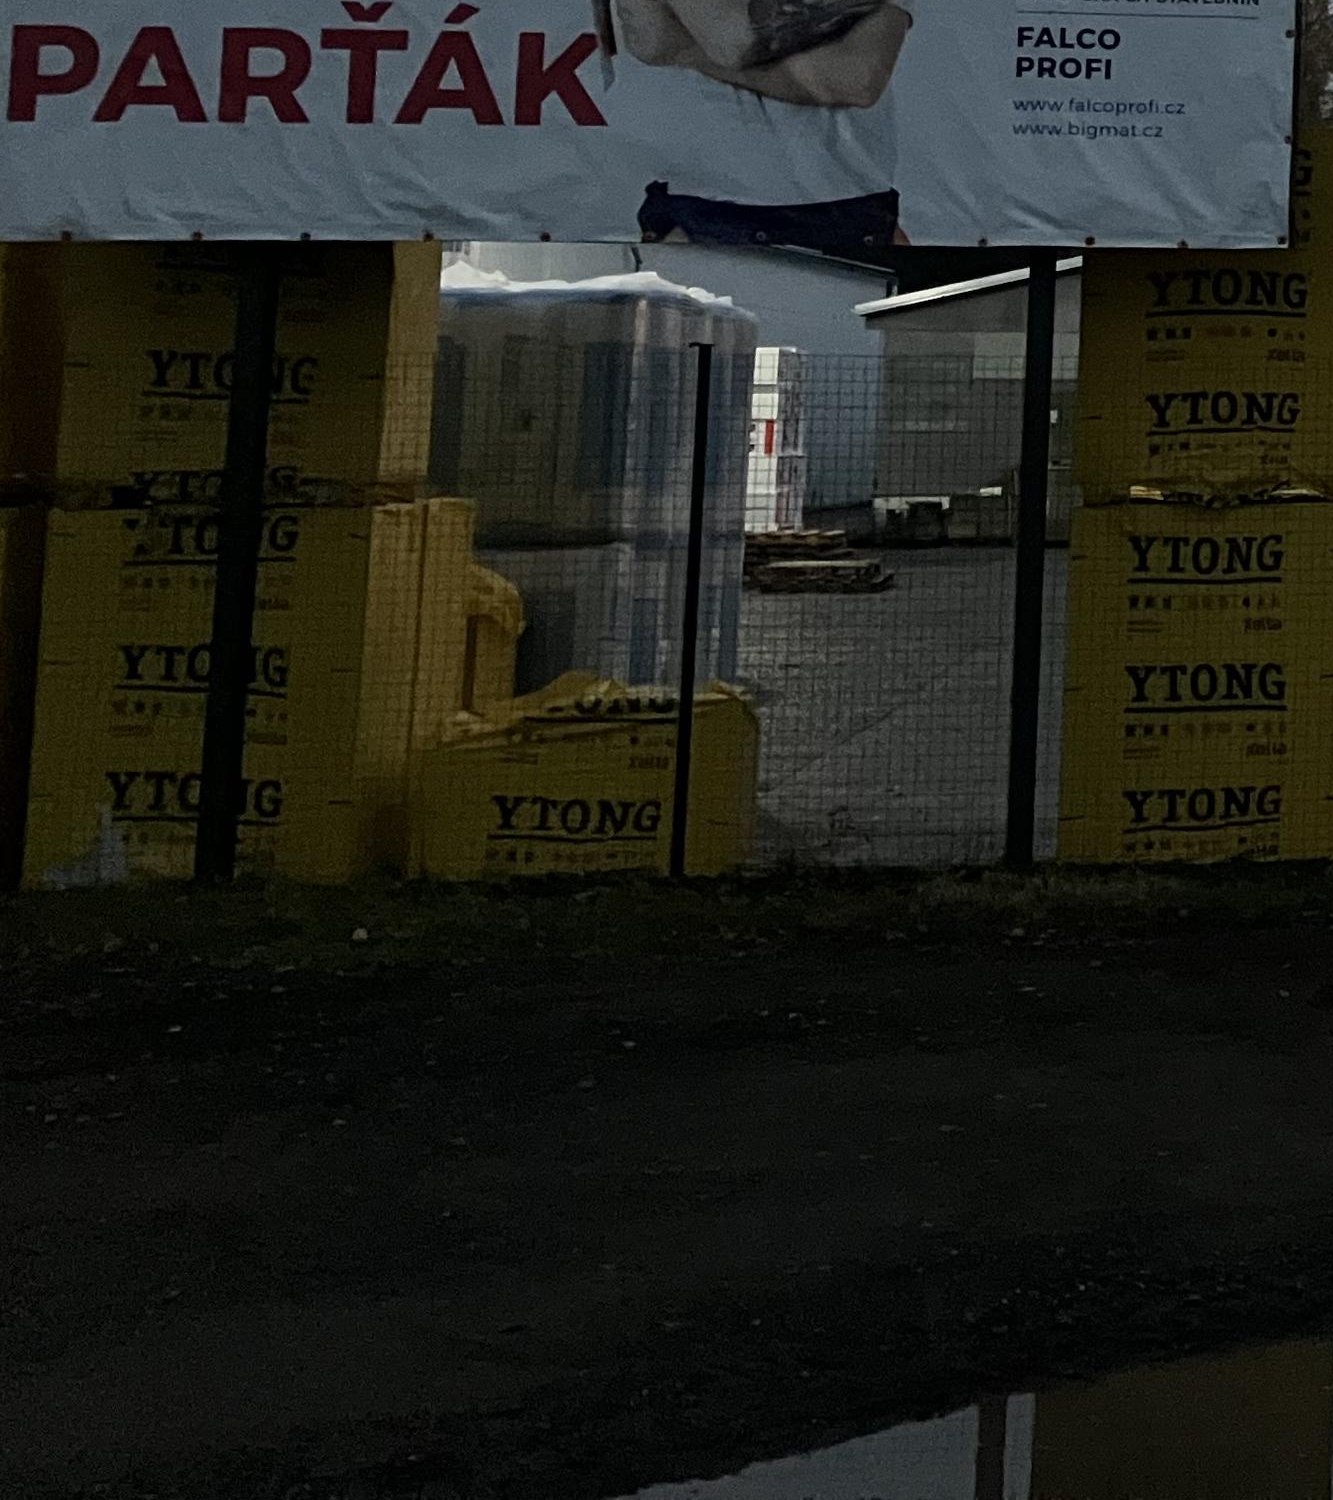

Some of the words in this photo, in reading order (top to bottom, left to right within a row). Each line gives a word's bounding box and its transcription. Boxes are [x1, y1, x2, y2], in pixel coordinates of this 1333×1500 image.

[1017, 26, 1121, 51] FALCO
[4, 0, 610, 128] PARŤÁK
[1015, 56, 1113, 80] PROFI
[1012, 97, 1186, 116] www.falcoprofi.cz
[1012, 121, 1164, 139] www.bigmat.cz
[1147, 268, 1308, 309] YTONG
[1146, 390, 1301, 428] YTONG
[1128, 535, 1285, 575] YTONG
[1125, 663, 1287, 702] YTONG
[490, 794, 662, 835] YTONG
[1122, 785, 1282, 823] YTONG
